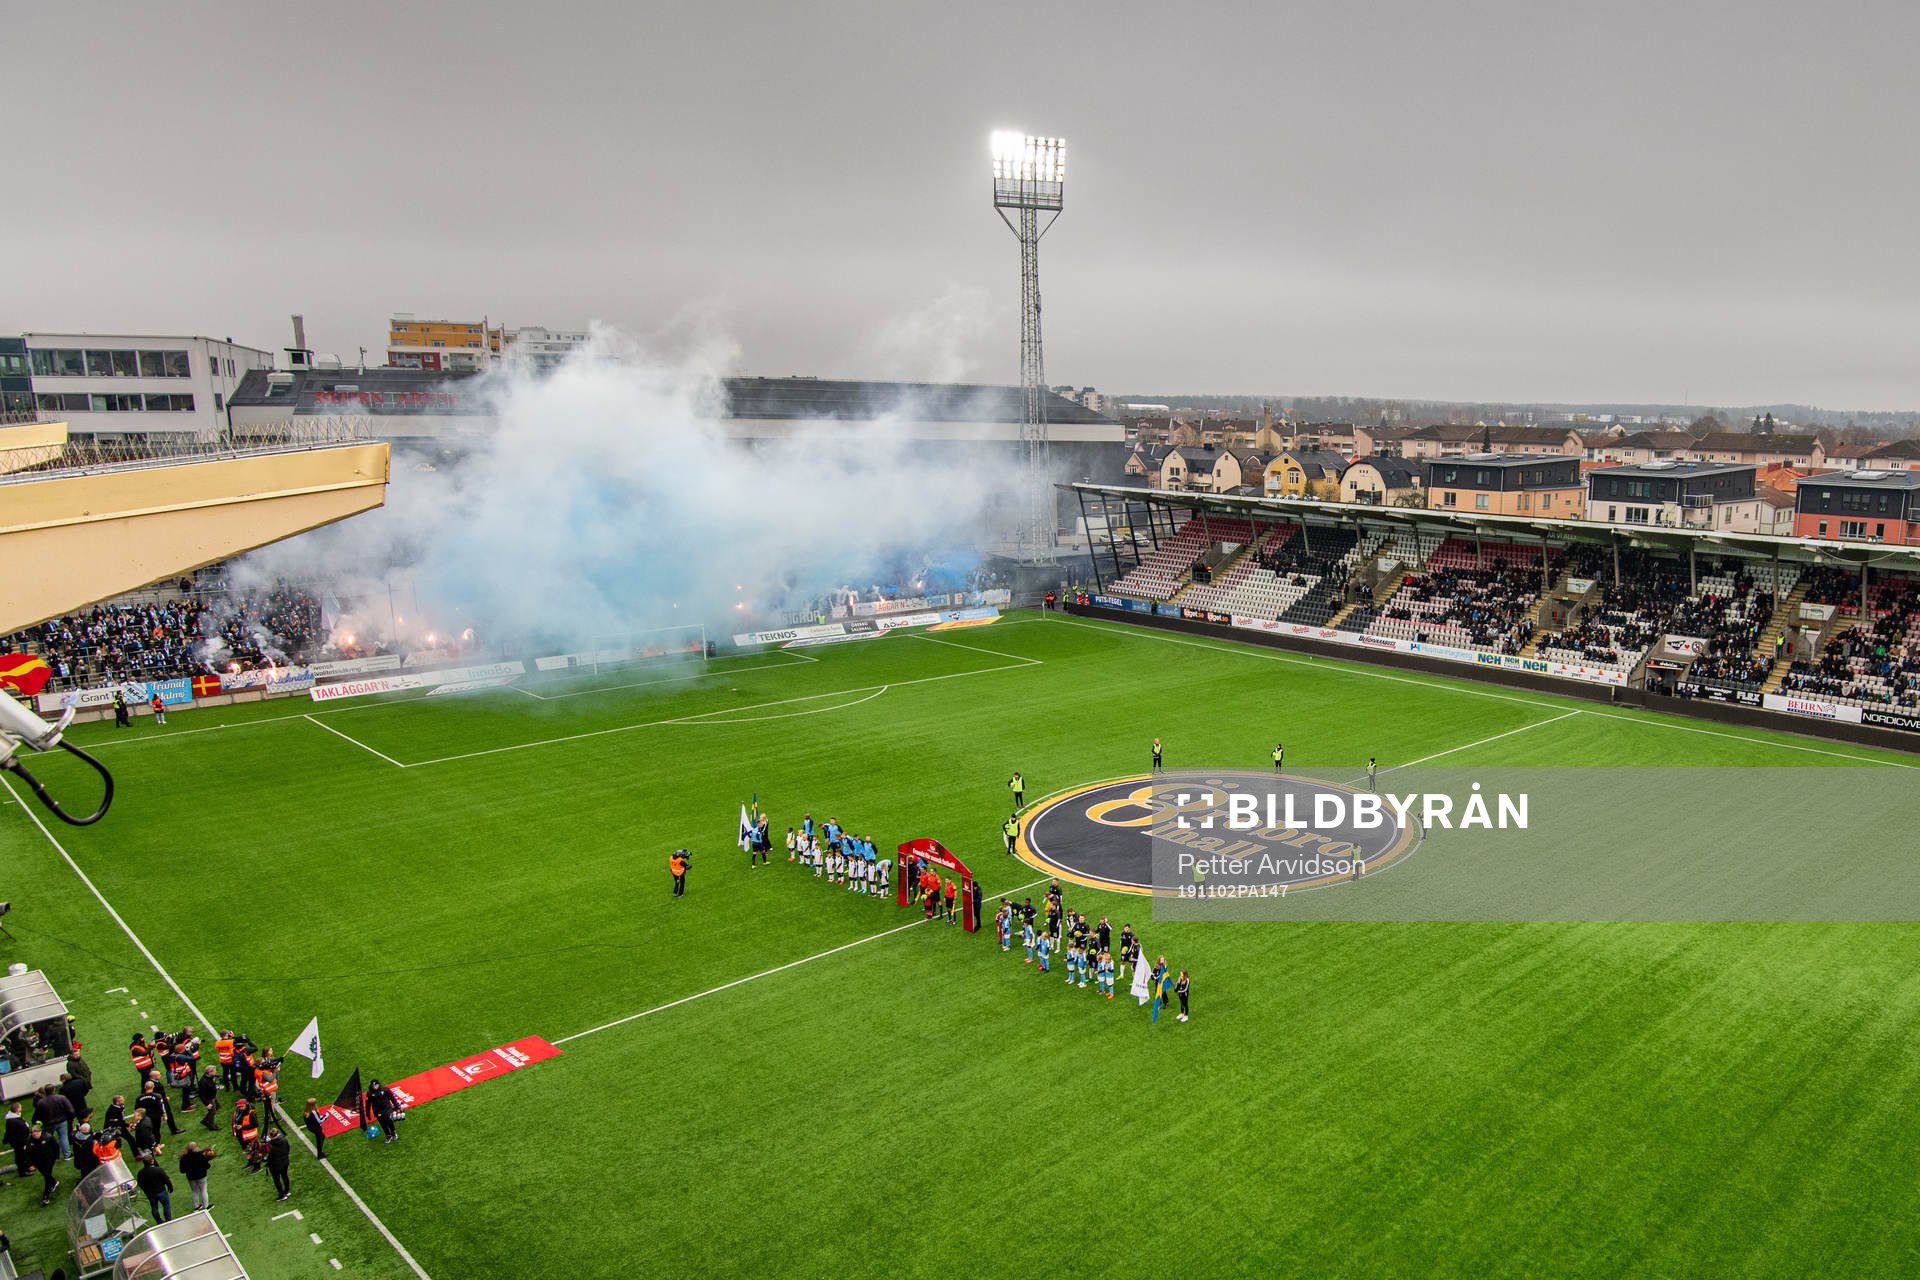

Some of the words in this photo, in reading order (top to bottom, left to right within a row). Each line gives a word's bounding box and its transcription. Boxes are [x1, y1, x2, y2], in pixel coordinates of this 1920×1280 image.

[759, 630, 798, 642] TEKNOS
[81, 692, 109, 703] Grant
[1736, 690, 1761, 702] FLEX
[1787, 700, 1823, 713] BEHRN
